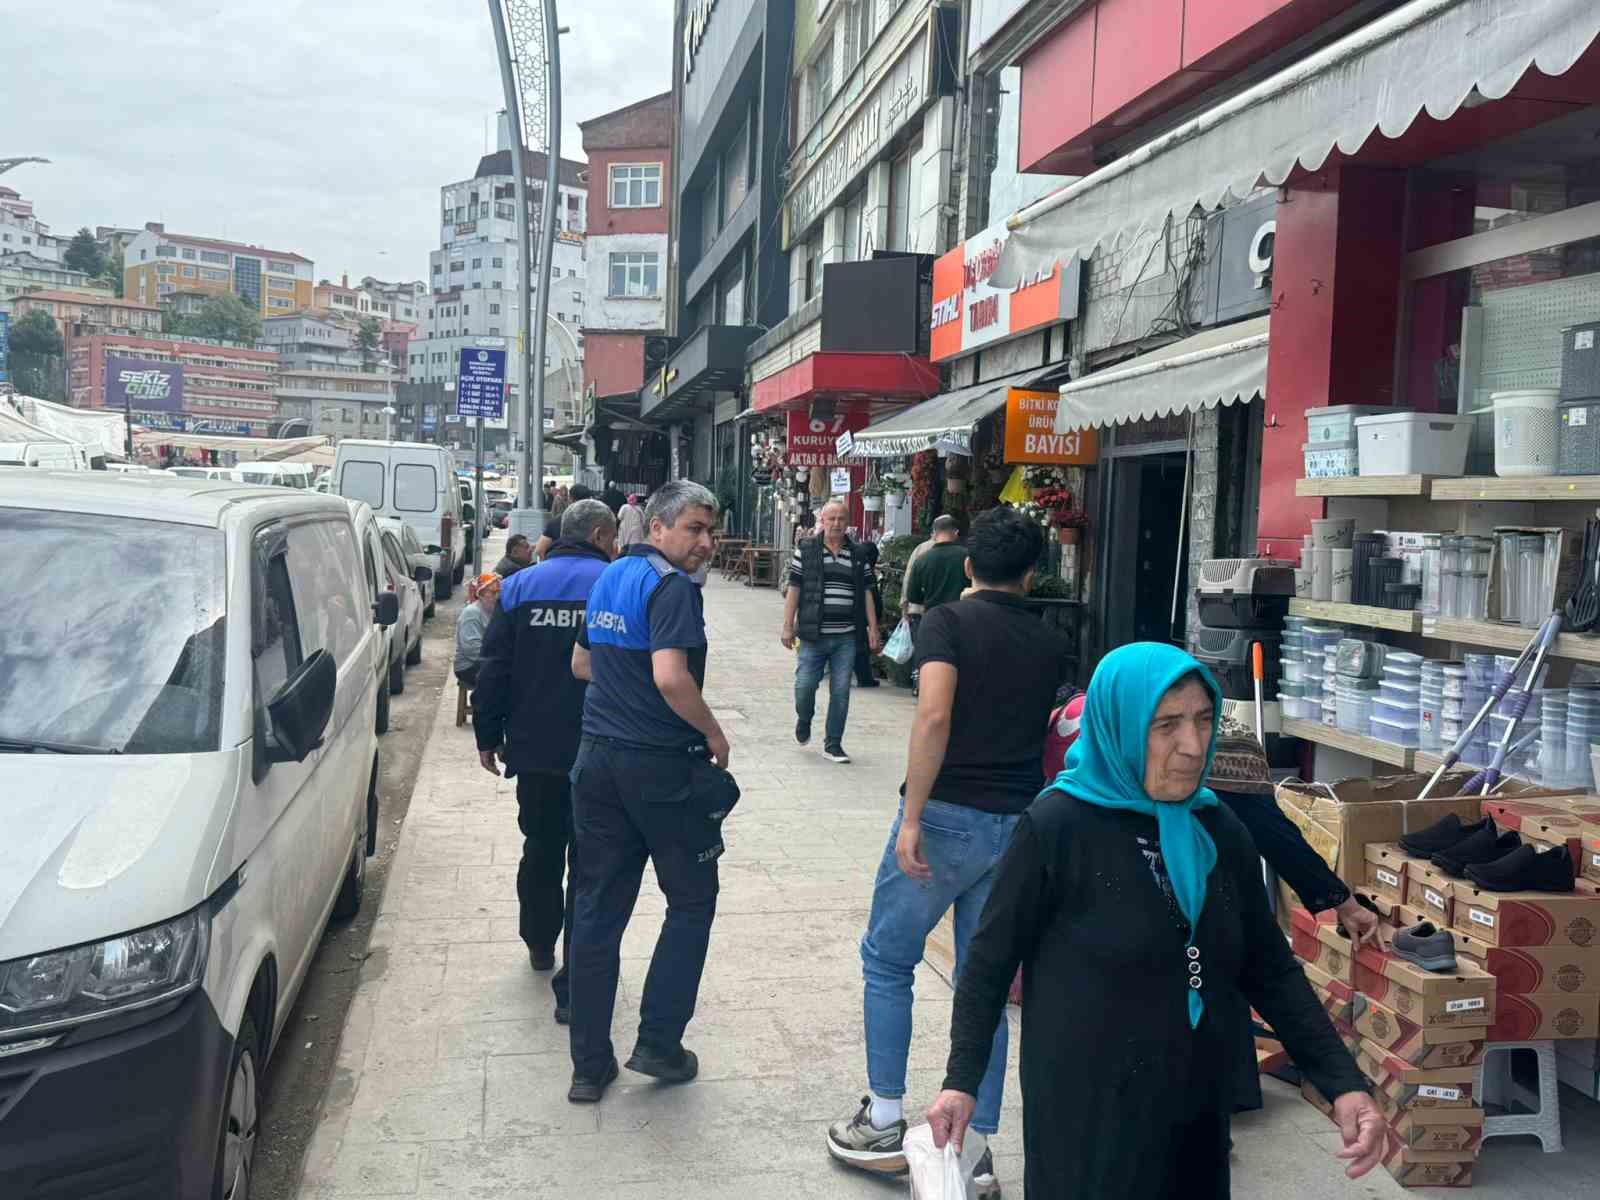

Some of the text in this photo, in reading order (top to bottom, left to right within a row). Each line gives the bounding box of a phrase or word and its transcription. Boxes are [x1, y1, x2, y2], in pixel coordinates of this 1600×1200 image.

[1047, 400, 1060, 411] KO
[794, 435, 836, 445] KURUY
[530, 607, 586, 628] ZABIT
